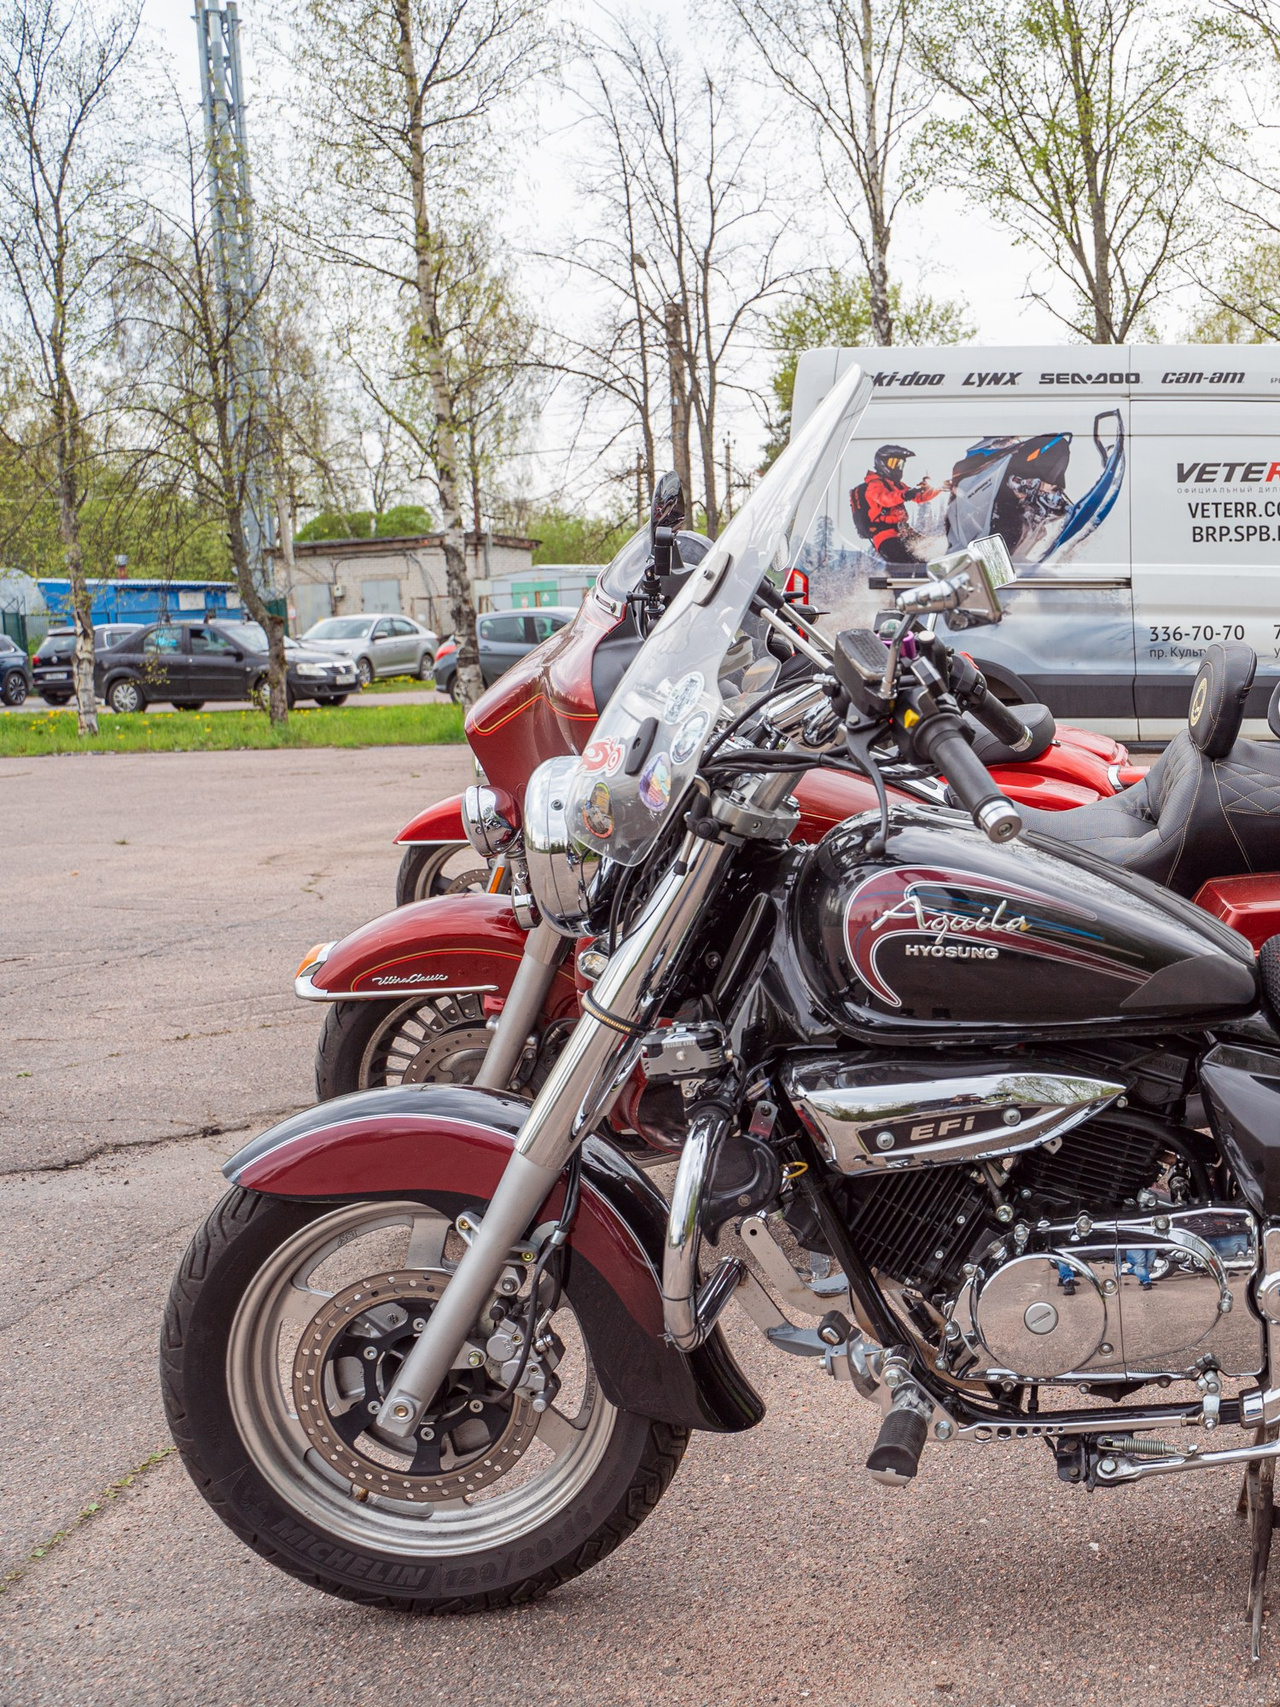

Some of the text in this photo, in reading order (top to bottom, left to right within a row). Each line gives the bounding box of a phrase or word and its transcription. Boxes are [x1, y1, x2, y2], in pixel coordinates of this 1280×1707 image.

[962, 372, 1023, 387] LYNX
[1161, 371, 1246, 384] can-am
[1177, 486, 1253, 494] ОФИЦИАЛЬНЫЙ
[1150, 625, 1245, 642] 336-70-70
[1150, 649, 1167, 660] пр.
[871, 895, 1033, 944] Aquila
[905, 944, 999, 960] HYOSUNG
[270, 1517, 427, 1587] MICHELIN
